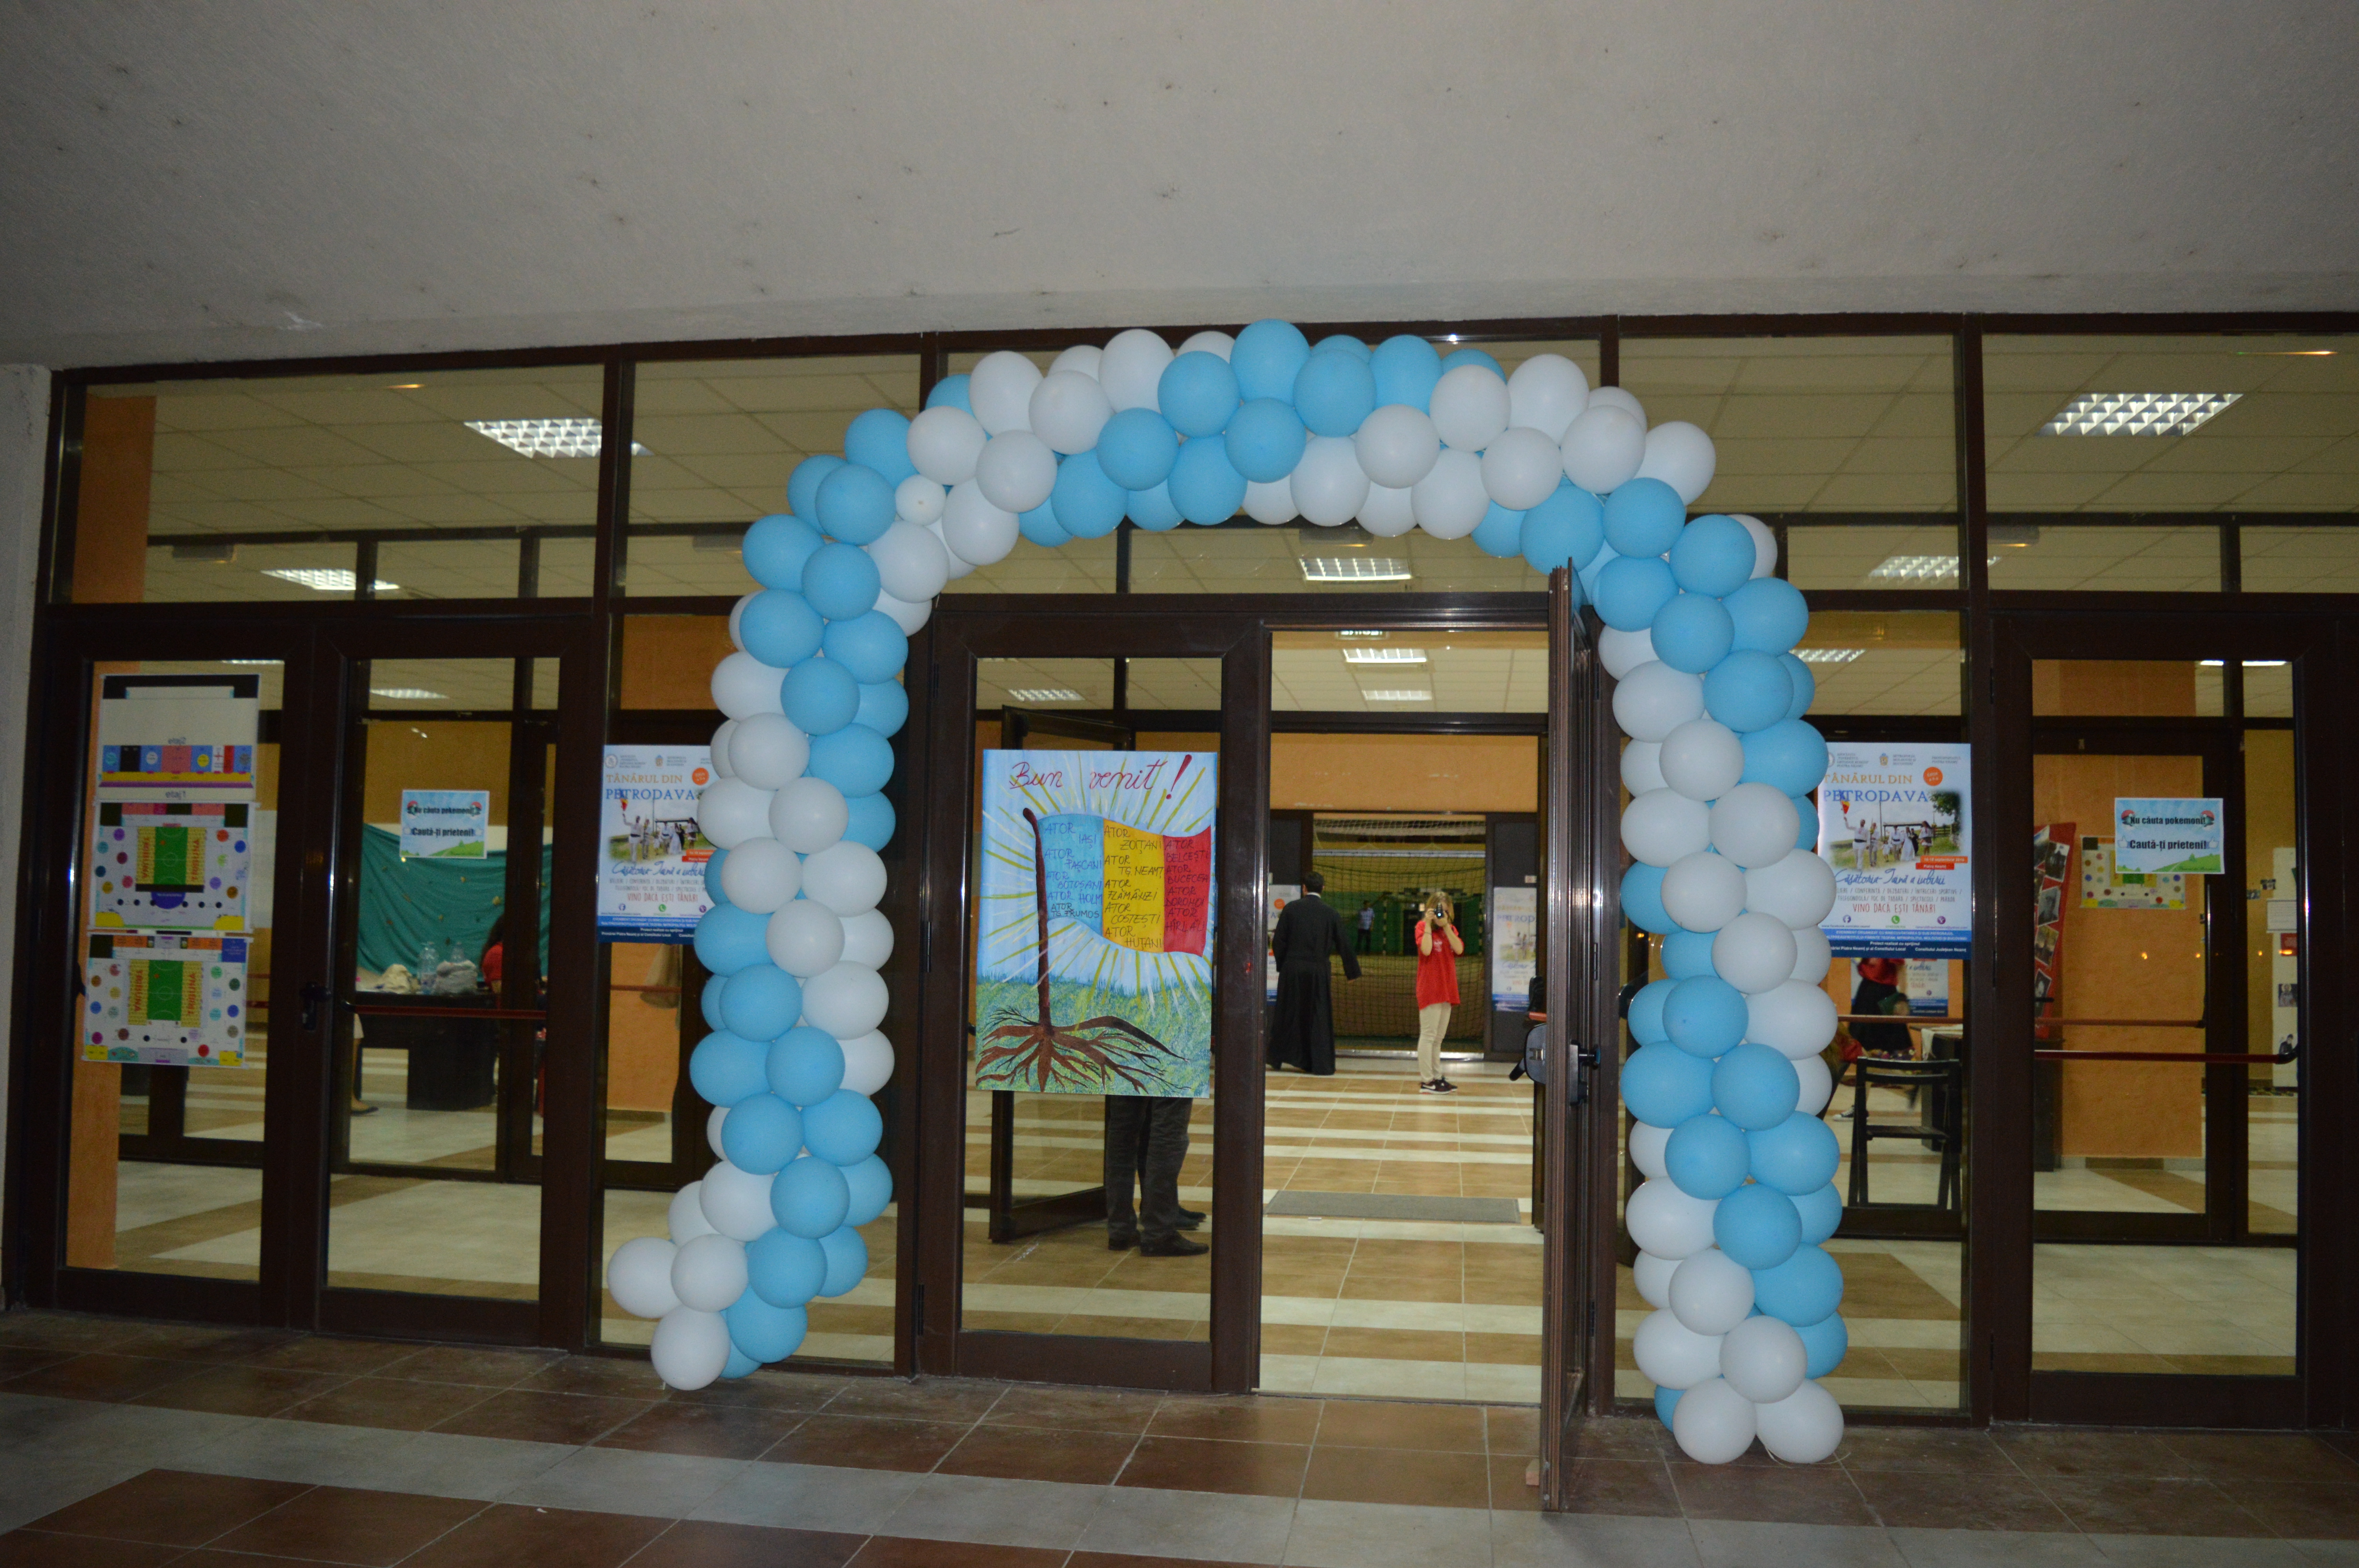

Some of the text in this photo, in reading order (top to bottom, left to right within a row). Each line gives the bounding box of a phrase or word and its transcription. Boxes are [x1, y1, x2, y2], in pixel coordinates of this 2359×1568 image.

[662, 775, 682, 783] DIN
[1009, 762, 1063, 789] Bun
[1888, 775, 1912, 783] DIN
[606, 789, 695, 800] PETRODAVA
[1823, 789, 1928, 802] PETRODAVA
[1044, 822, 1076, 835] ATOR
[1104, 825, 1130, 838] ATOR
[1079, 834, 1096, 849] IAȘI
[1165, 839, 1194, 850] ATOR
[2130, 840, 2206, 851] Caută-ți prieteni!
[1044, 848, 1074, 859] ATOR
[1166, 850, 1210, 862] BELCEȘTI
[1065, 856, 1102, 872] PAȘCANI
[1105, 855, 1130, 865] ATOR
[1134, 866, 1164, 878] NEAMȚ
[1166, 865, 1190, 874] ATOR
[1046, 871, 1069, 880] ATOR
[1167, 874, 1208, 884] BUCECEA
[1058, 878, 1102, 892] BOTOȘANI
[1105, 879, 1131, 888] ATOR
[1047, 891, 1075, 901] ATOR
[1168, 886, 1196, 896] ATOR
[1164, 896, 1204, 907] DOROHOI
[1105, 902, 1130, 913] ATOR
[1167, 907, 1197, 917] ATOR
[1853, 904, 1870, 912] VINO
[1065, 909, 1100, 918] FRUMOS
[1111, 911, 1160, 928] COSTEȘTI
[1105, 926, 1136, 937] ATOR
[1125, 934, 1163, 950] HUȚANI
[134, 970, 144, 1012] TRIBUNA
[188, 973, 196, 1015] TRIBUNA
